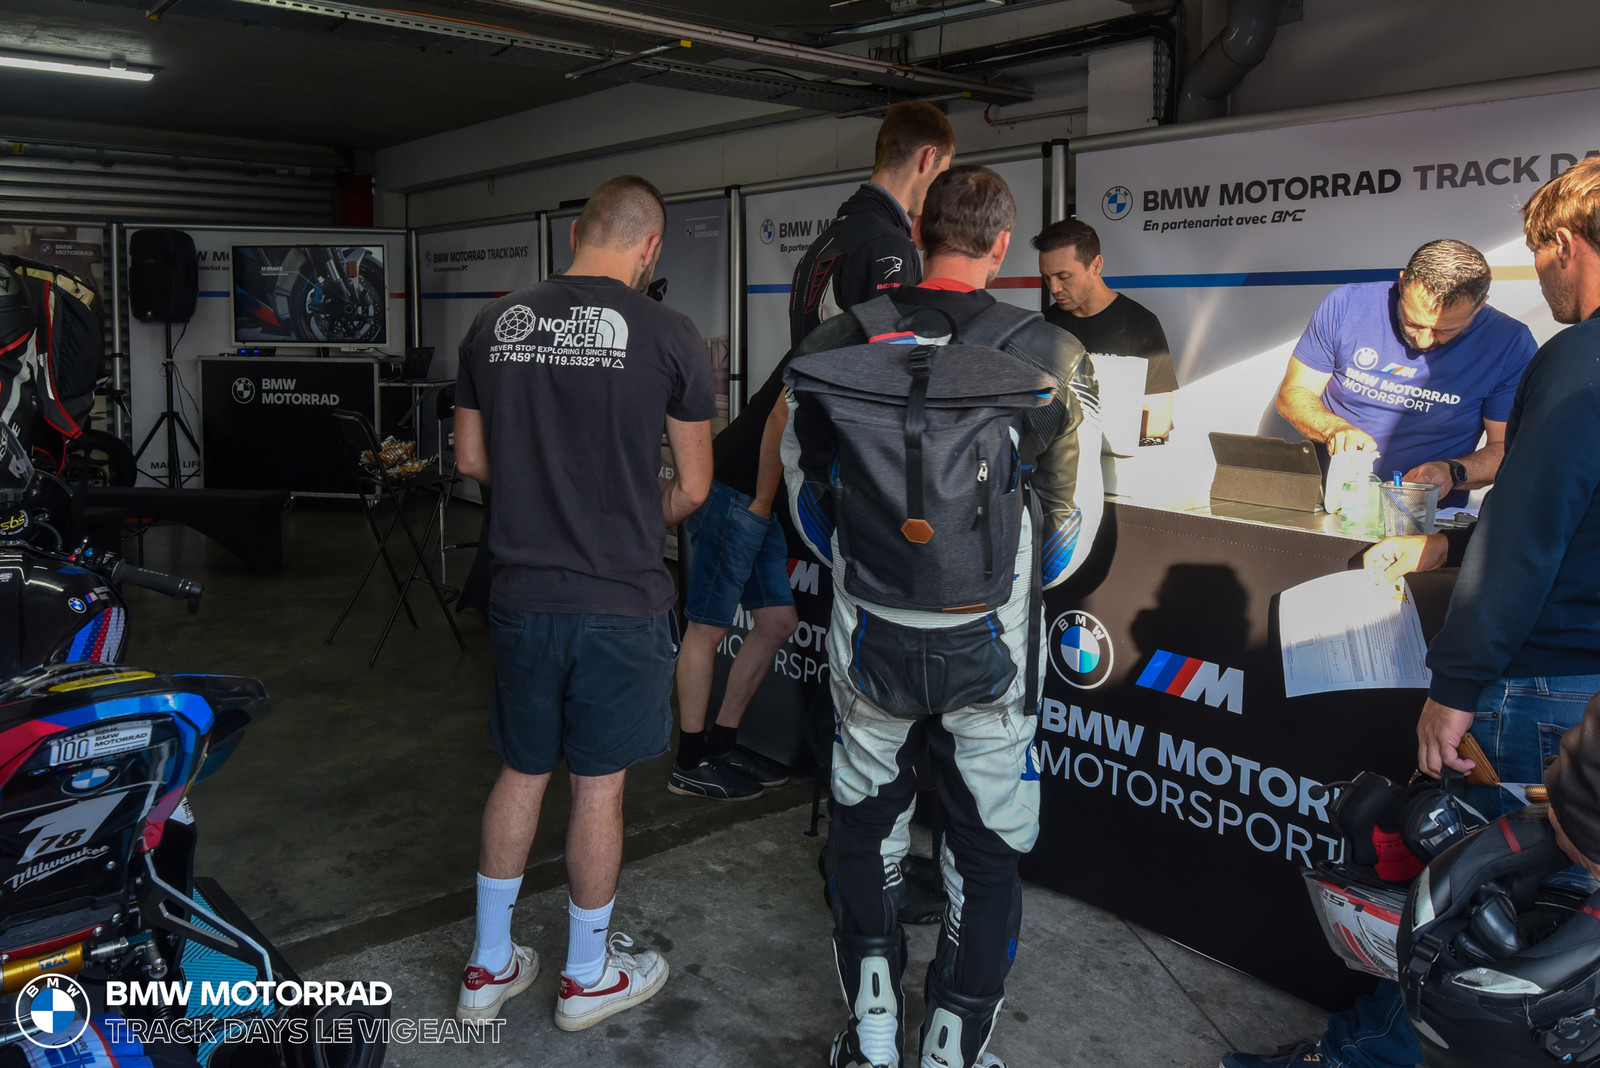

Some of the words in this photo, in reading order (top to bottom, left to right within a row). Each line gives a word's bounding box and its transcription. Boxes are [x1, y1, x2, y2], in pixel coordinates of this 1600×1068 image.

[1143, 185, 1210, 212] BMW
[1219, 168, 1402, 206] MOTORRAD
[1413, 154, 1541, 191] TRACK
[779, 220, 812, 238] BMW
[1143, 220, 1159, 231] En
[1161, 214, 1233, 233] partenariat
[1236, 214, 1267, 226] avec
[433, 253, 449, 263] BMW
[450, 250, 486, 262] MOTORRAD
[488, 248, 508, 260] TRACK
[510, 246, 528, 258] DAYS
[788, 244, 811, 254] parten
[570, 306, 601, 320] THE
[538, 317, 598, 334] NORTH
[553, 333, 595, 347] FACE
[490, 344, 513, 353] NEVER
[515, 344, 536, 352] STOP
[537, 346, 580, 355] EXPLORING
[585, 349, 607, 357] SINCE
[609, 350, 626, 358] 1966
[536, 354, 546, 364] N
[601, 357, 612, 368] W
[262, 378, 297, 391] BMW
[1345, 367, 1380, 388] BMW
[1380, 380, 1461, 405] MOTORRAD
[262, 393, 341, 406] MOTORRAD
[1342, 377, 1434, 413] MOTORSPORT
[94, 732, 147, 747] MOTORRAD
[95, 732, 119, 741] BMW
[1042, 697, 1145, 757] BMW
[1158, 732, 1340, 824] MOTOR
[1040, 741, 1339, 870] MOTORSPORT
[33, 828, 87, 856] 78
[3, 845, 112, 890] Milwaukee
